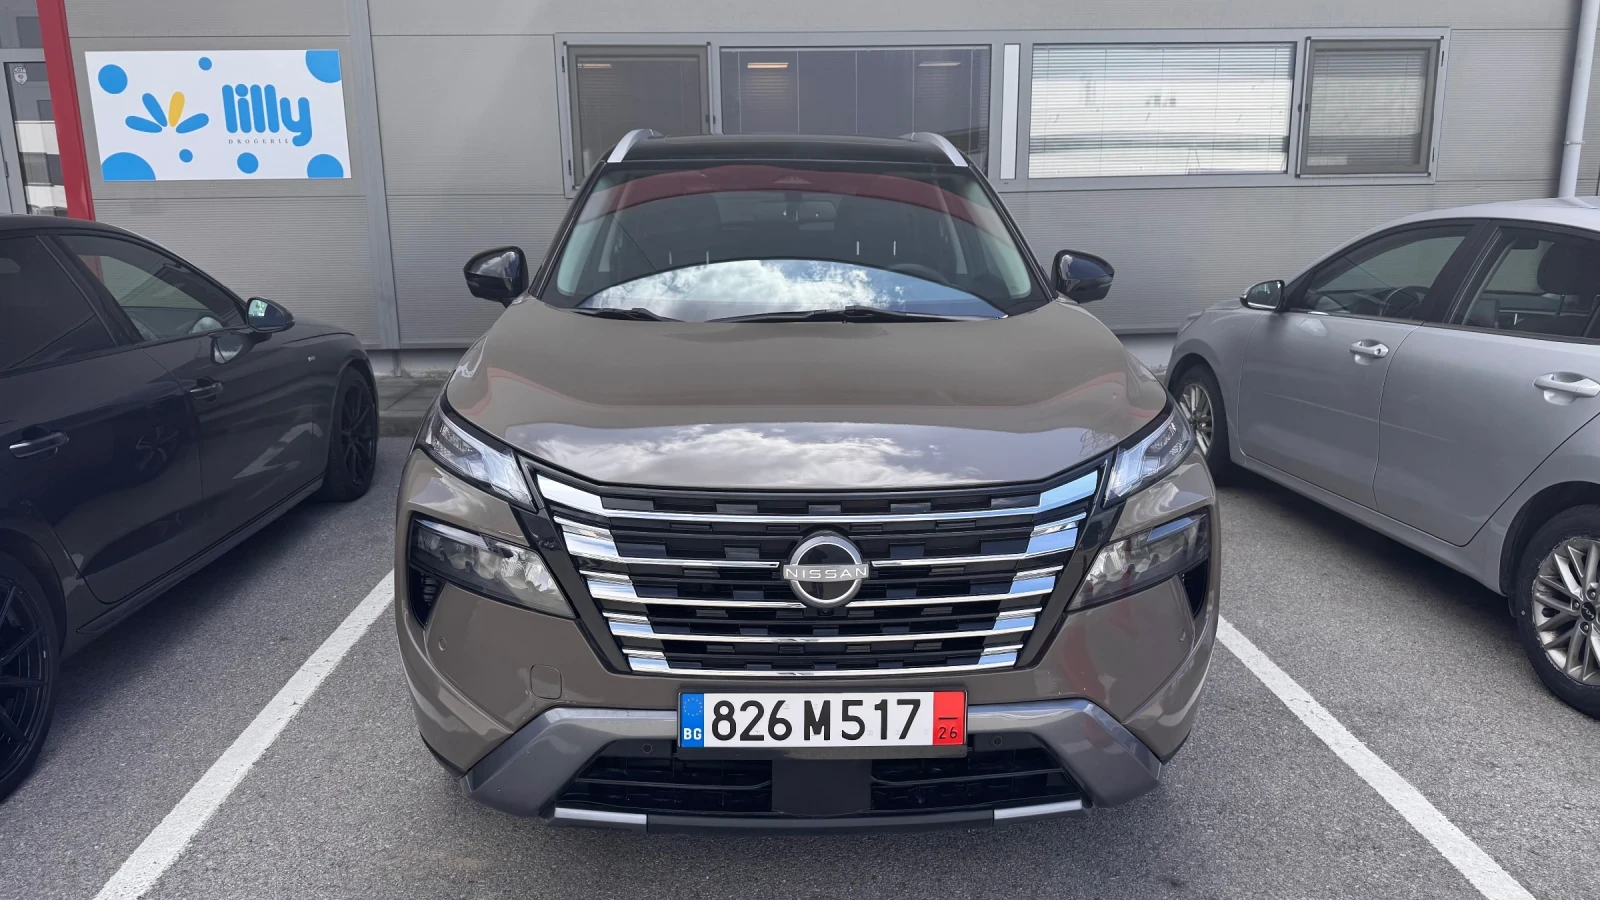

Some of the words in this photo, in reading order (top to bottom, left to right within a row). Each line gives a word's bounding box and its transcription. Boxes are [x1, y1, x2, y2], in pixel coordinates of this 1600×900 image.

[222, 83, 312, 147] lilly
[785, 567, 867, 579] NISSAN
[683, 727, 702, 740] BG
[938, 726, 958, 739] 26
